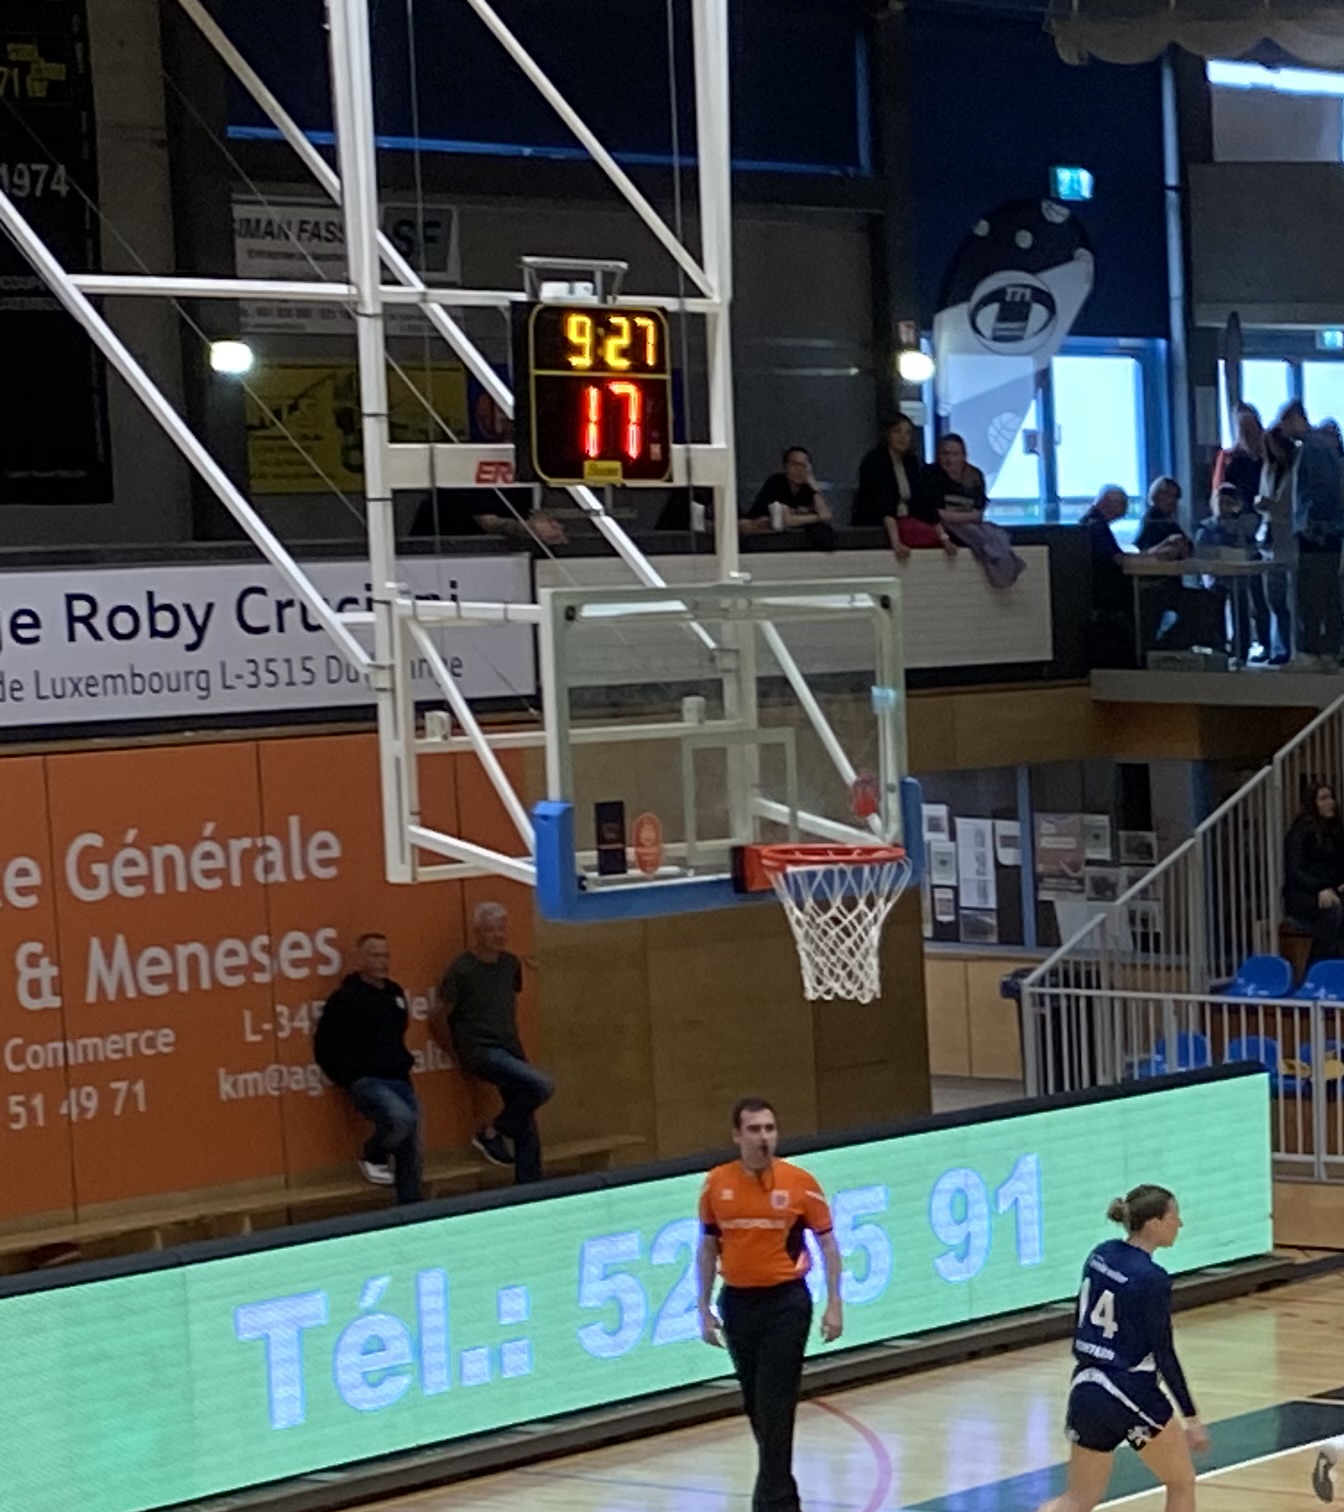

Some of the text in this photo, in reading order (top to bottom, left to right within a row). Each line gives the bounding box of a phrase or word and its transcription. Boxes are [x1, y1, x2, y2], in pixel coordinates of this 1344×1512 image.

[565, 312, 656, 370] 9:27
[586, 380, 643, 461] 17
[64, 590, 215, 652] Roby
[34, 664, 211, 701] Luxembourg
[219, 655, 316, 690] L-3515
[65, 814, 342, 903] Générale
[15, 940, 62, 1011] &
[85, 927, 342, 1004] Meneses
[4, 1027, 176, 1074] Commerce
[8, 1078, 146, 1130] 51 49 71
[235, 1267, 532, 1429] Tél.:
[578, 1217, 703, 1358] 52
[930, 1153, 1043, 1283] 91
